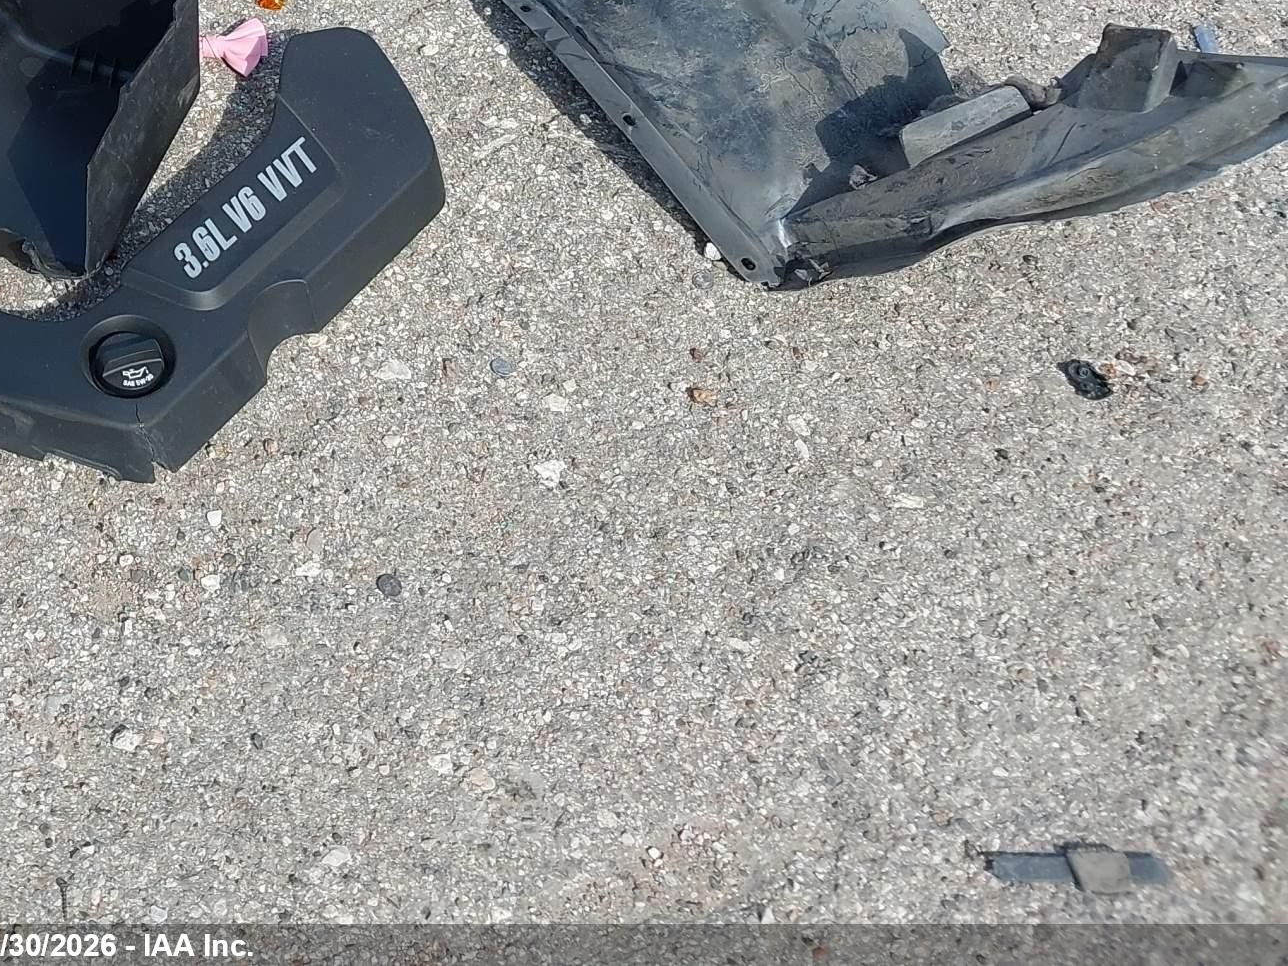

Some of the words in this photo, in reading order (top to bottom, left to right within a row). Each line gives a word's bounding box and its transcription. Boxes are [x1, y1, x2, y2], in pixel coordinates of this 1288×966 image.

[174, 218, 238, 278] 3.6L
[222, 186, 266, 233] V6
[257, 136, 317, 202] VVT
